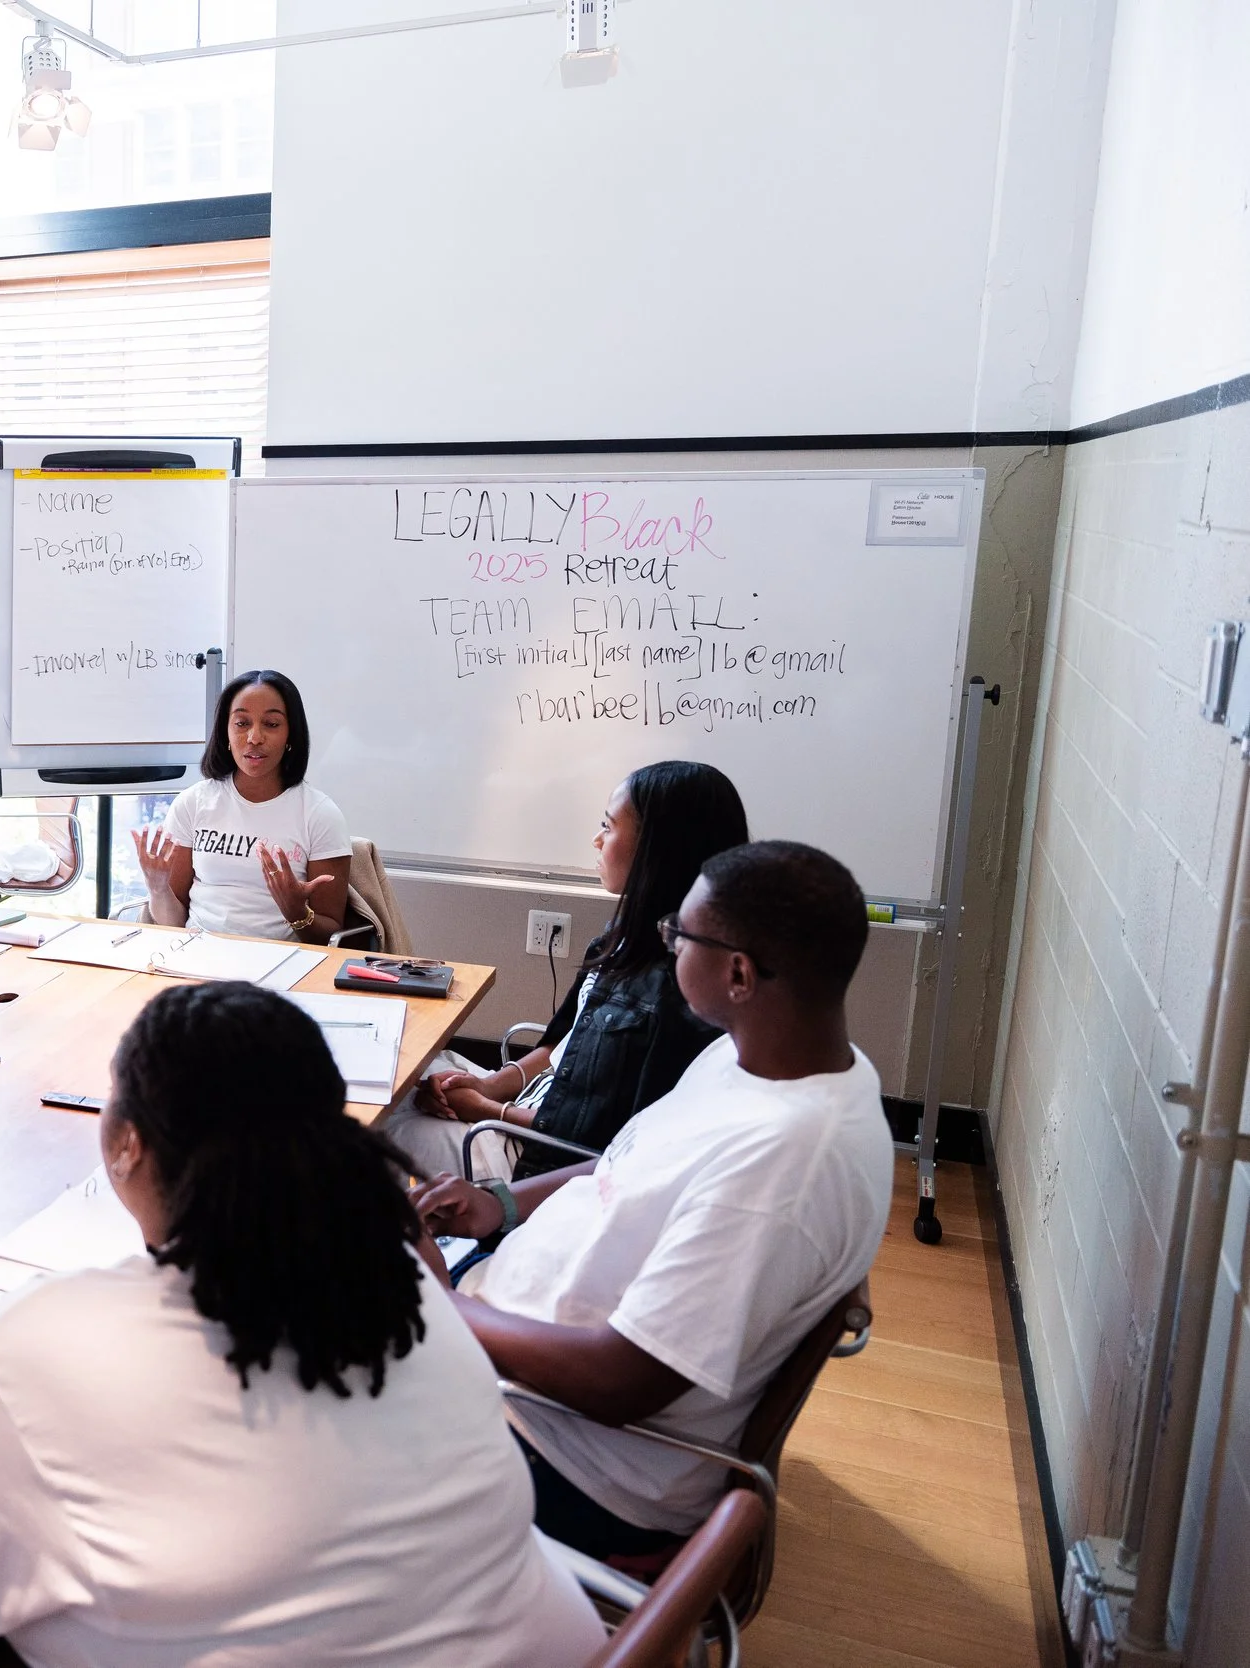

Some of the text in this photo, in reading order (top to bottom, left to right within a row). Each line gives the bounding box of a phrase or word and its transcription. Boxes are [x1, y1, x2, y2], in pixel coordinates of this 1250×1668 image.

[37, 492, 113, 515] Name
[394, 487, 727, 560] LEGALLY Black
[467, 551, 680, 591] 2025 Retreat
[418, 592, 760, 636] TEAM EMAIL:
